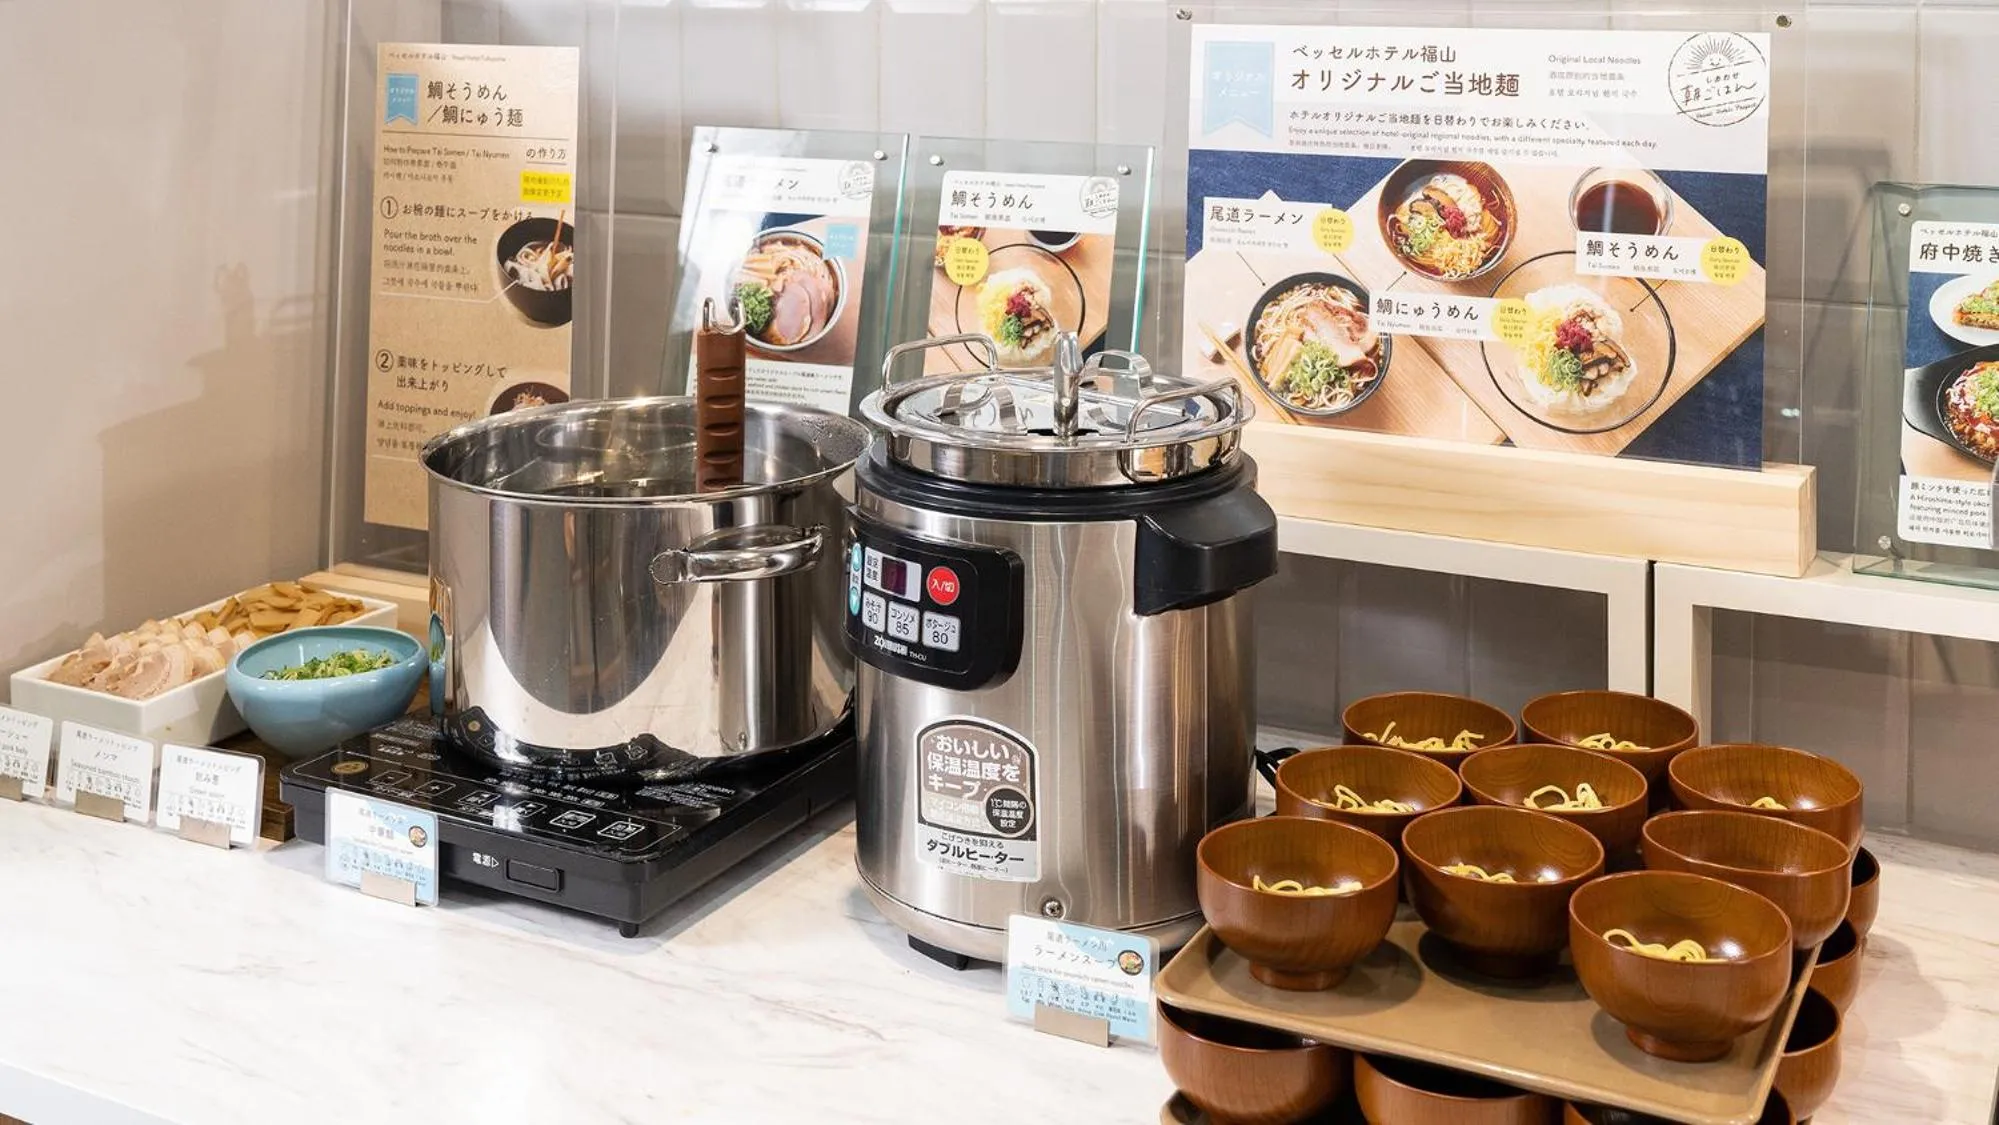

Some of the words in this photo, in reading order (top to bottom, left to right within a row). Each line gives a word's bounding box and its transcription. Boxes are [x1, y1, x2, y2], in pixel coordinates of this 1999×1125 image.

[1293, 45, 1456, 63] ベッセルホテル福山
[1548, 54, 1581, 64] Original
[1607, 56, 1641, 64] Noodles
[1291, 68, 1520, 97] オリジナルご当地麺
[1707, 72, 1739, 84] しあわせ
[426, 80, 508, 101] 鯛そうめん
[1289, 110, 1590, 130] ホテルオリジナルご当地麺を日替わりでお楽しみください。
[1315, 127, 1337, 136] unique
[1622, 139, 1640, 147] each
[384, 146, 396, 154] How
[526, 147, 567, 160] の作り方
[951, 190, 1033, 209] 鯛そうめん
[1210, 205, 1304, 224] 尾道ラーメン
[384, 228, 402, 239] Pour
[404, 231, 417, 240] the
[420, 232, 442, 241] broth
[443, 235, 462, 243] over
[464, 234, 478, 245] the
[1920, 229, 1998, 238] ベッセルホテル福山
[383, 243, 414, 253] noodles
[417, 246, 424, 254] in
[426, 247, 431, 255] a
[433, 247, 455, 256] bowl.
[1586, 239, 1679, 260] 鯛そうめん
[1710, 245, 1740, 254] 日替わり
[1376, 298, 1479, 321] 鯛にゅうめん
[1500, 305, 1527, 315] 日替わり
[397, 355, 508, 379] 薬味をトッピングして
[396, 375, 450, 393] 出来上がり
[378, 400, 394, 411] Add
[396, 402, 432, 418] toppings
[433, 405, 448, 417] and
[1917, 495, 1971, 506] Hiroshima-style
[1910, 504, 1941, 515] featuring
[931, 580, 955, 593] 入/切
[867, 611, 879, 625] 90
[890, 608, 915, 623] コンソメ
[896, 621, 910, 635] 85
[925, 618, 957, 634] ポタージュ
[932, 631, 949, 645] 80
[936, 734, 1010, 759] おいしい
[95, 751, 118, 761] メンマ
[928, 752, 1020, 782] 保温温度を
[929, 774, 981, 800] キープ
[942, 832, 1004, 849] こげつきを抑える
[472, 852, 491, 867] 電源
[927, 839, 1024, 864] ダブルヒーター
[1047, 931, 1107, 952] 尾道ラーメン用
[1034, 944, 1118, 969] ラーメンスープ
